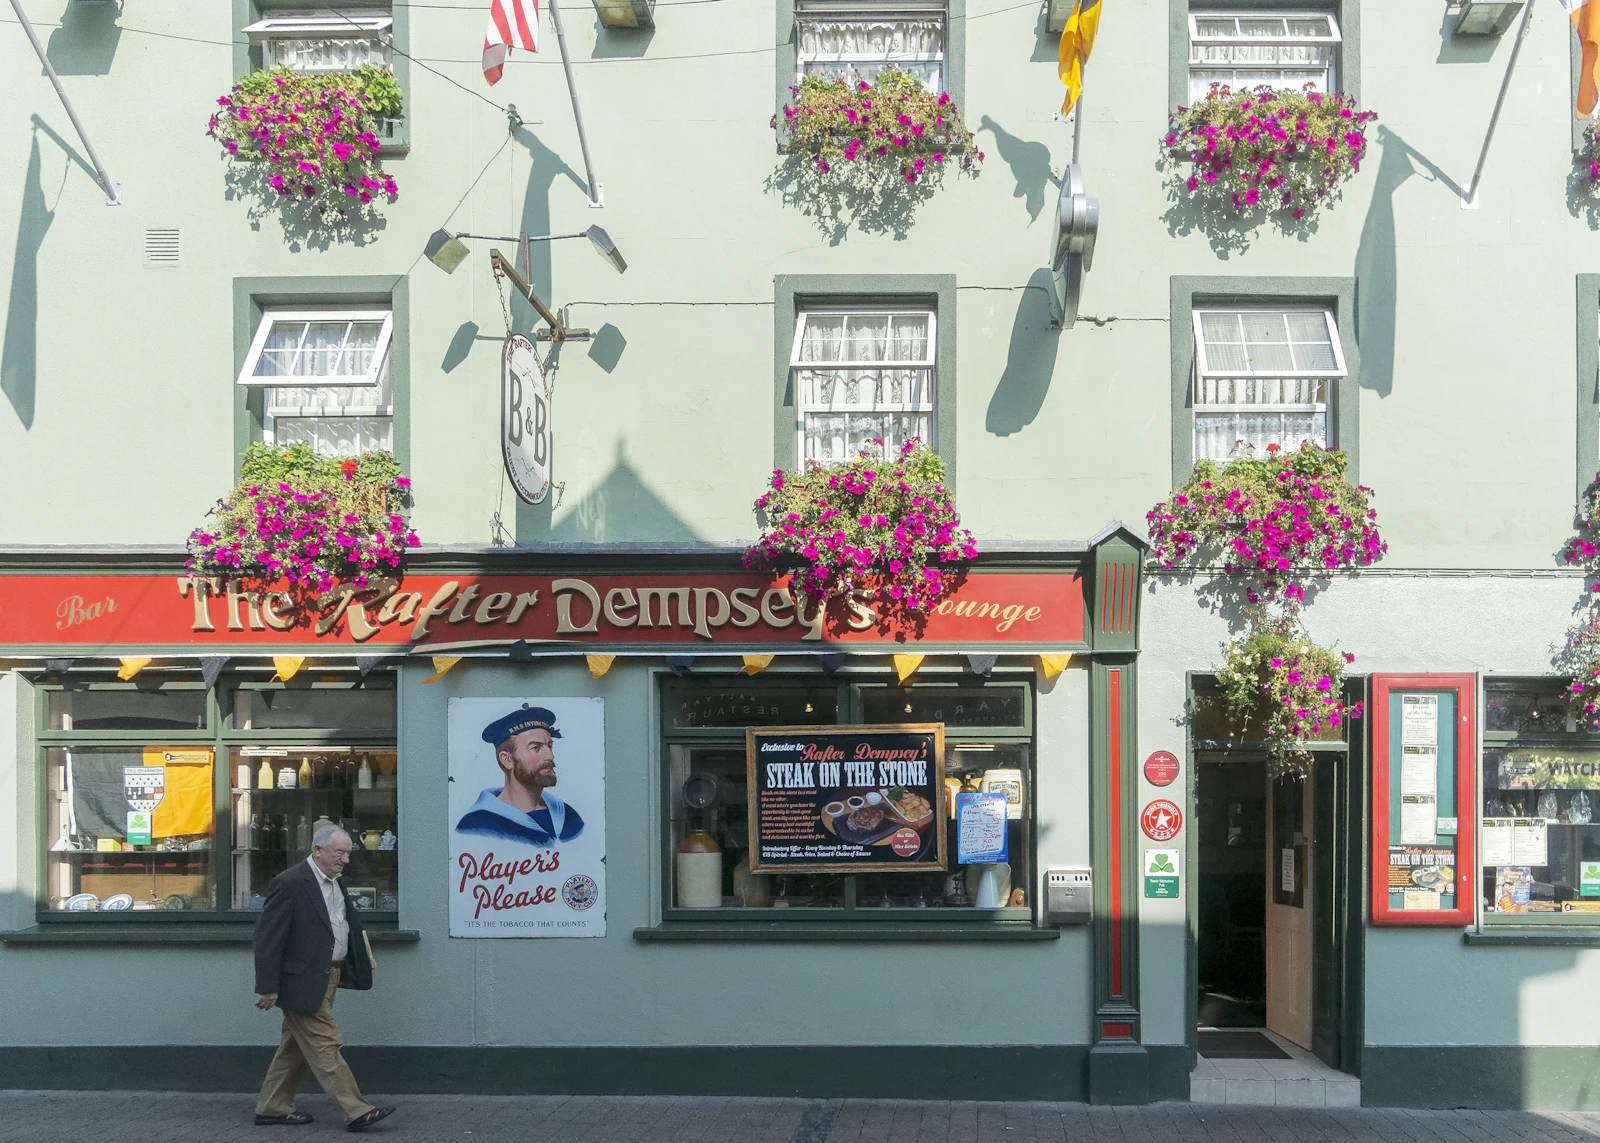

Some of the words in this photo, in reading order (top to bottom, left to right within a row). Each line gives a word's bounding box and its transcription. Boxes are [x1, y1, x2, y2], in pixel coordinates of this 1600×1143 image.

[56, 594, 118, 630] Bar
[177, 577, 295, 633] The
[314, 576, 540, 642] Rafter
[551, 577, 876, 640] Dempsey's
[908, 596, 1042, 632] ounge
[761, 742, 795, 752] Exclusive
[795, 743, 805, 751] to
[800, 742, 845, 764] Rafter
[853, 741, 927, 762] Dempsey's
[766, 762, 815, 789] STEAK
[819, 762, 841, 788] ON
[844, 761, 875, 788] THE
[878, 760, 928, 787] STONE
[1548, 763, 1600, 776] WATCH
[459, 850, 560, 893] Player's
[1390, 854, 1410, 865] STEAK
[1411, 854, 1420, 865] ON
[1421, 854, 1434, 865] THE
[472, 884, 557, 919] Please
